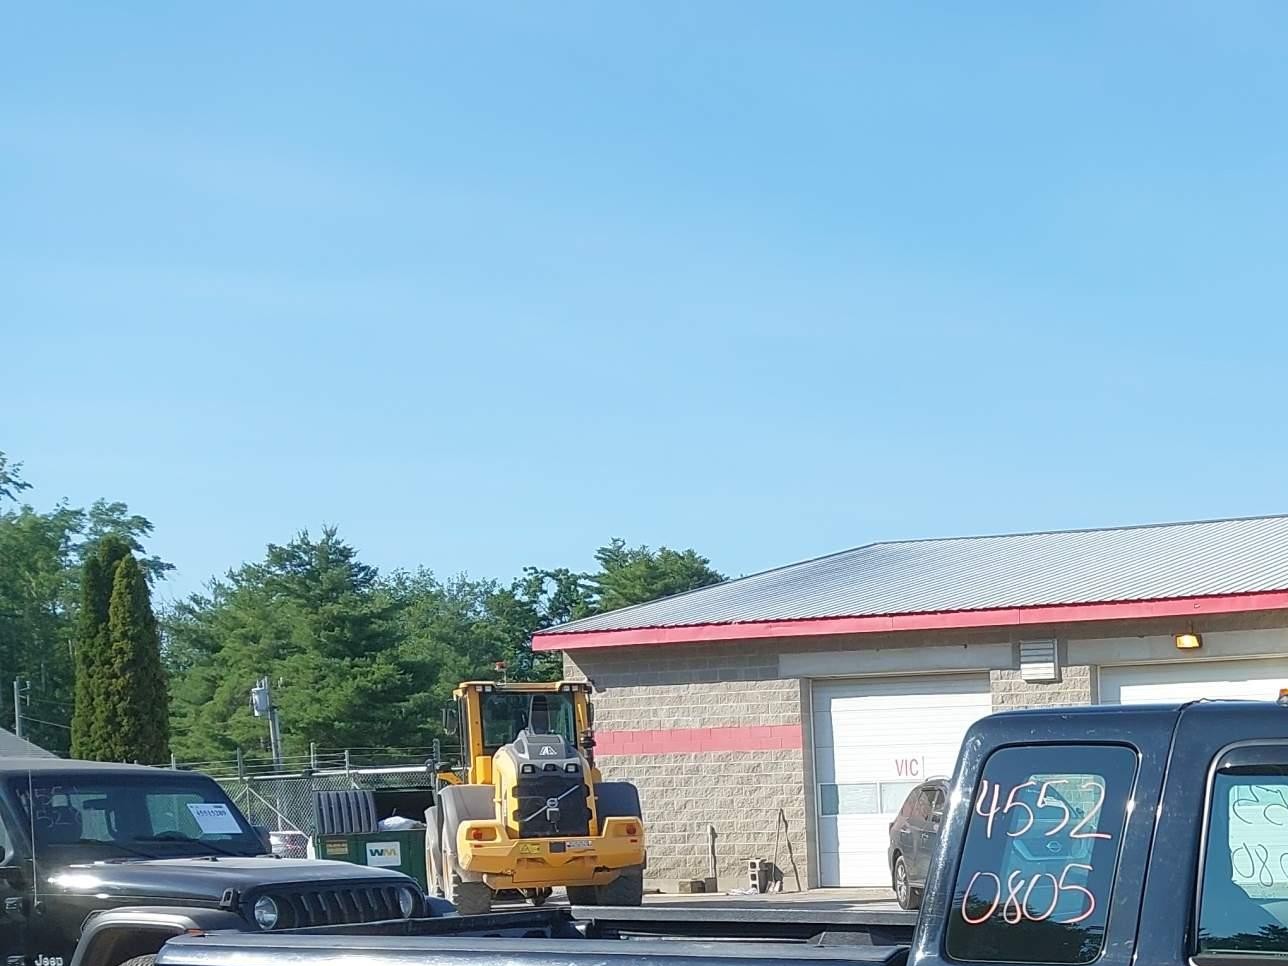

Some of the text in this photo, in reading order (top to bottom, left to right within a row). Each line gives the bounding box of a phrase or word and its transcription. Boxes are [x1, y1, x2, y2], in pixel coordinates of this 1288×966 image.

[895, 758, 918, 776] VIC
[975, 779, 1112, 839] 4552
[369, 848, 397, 857] WM
[961, 862, 1096, 925] 0805
